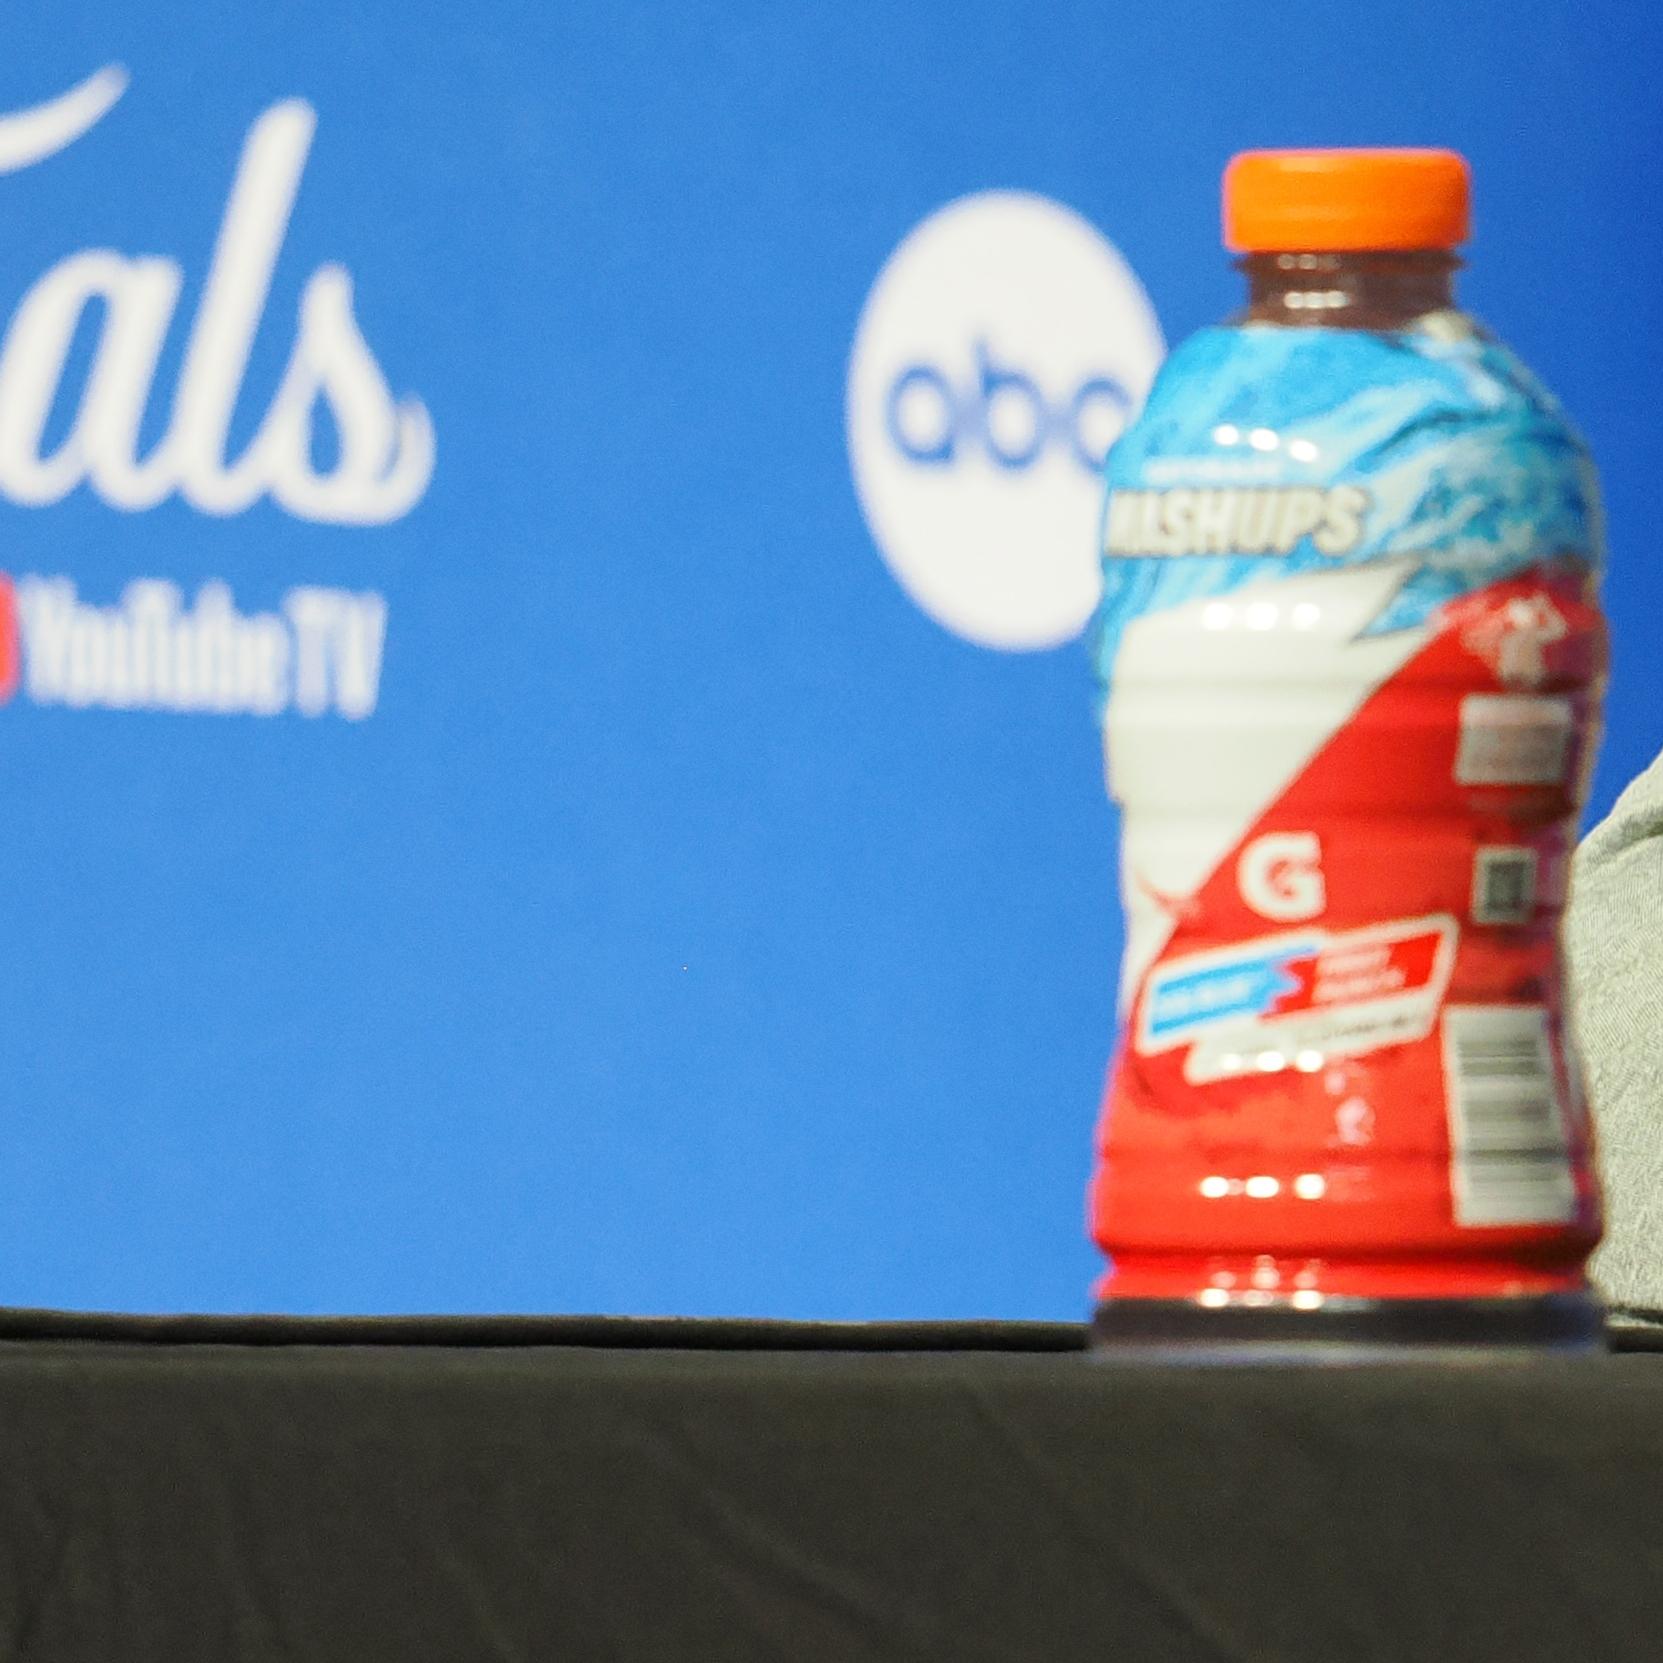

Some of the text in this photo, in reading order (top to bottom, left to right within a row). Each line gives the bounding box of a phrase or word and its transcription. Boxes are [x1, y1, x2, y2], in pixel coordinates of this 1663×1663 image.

[886, 334, 1132, 472] abc
[20, 575, 388, 723] YouTube TV
